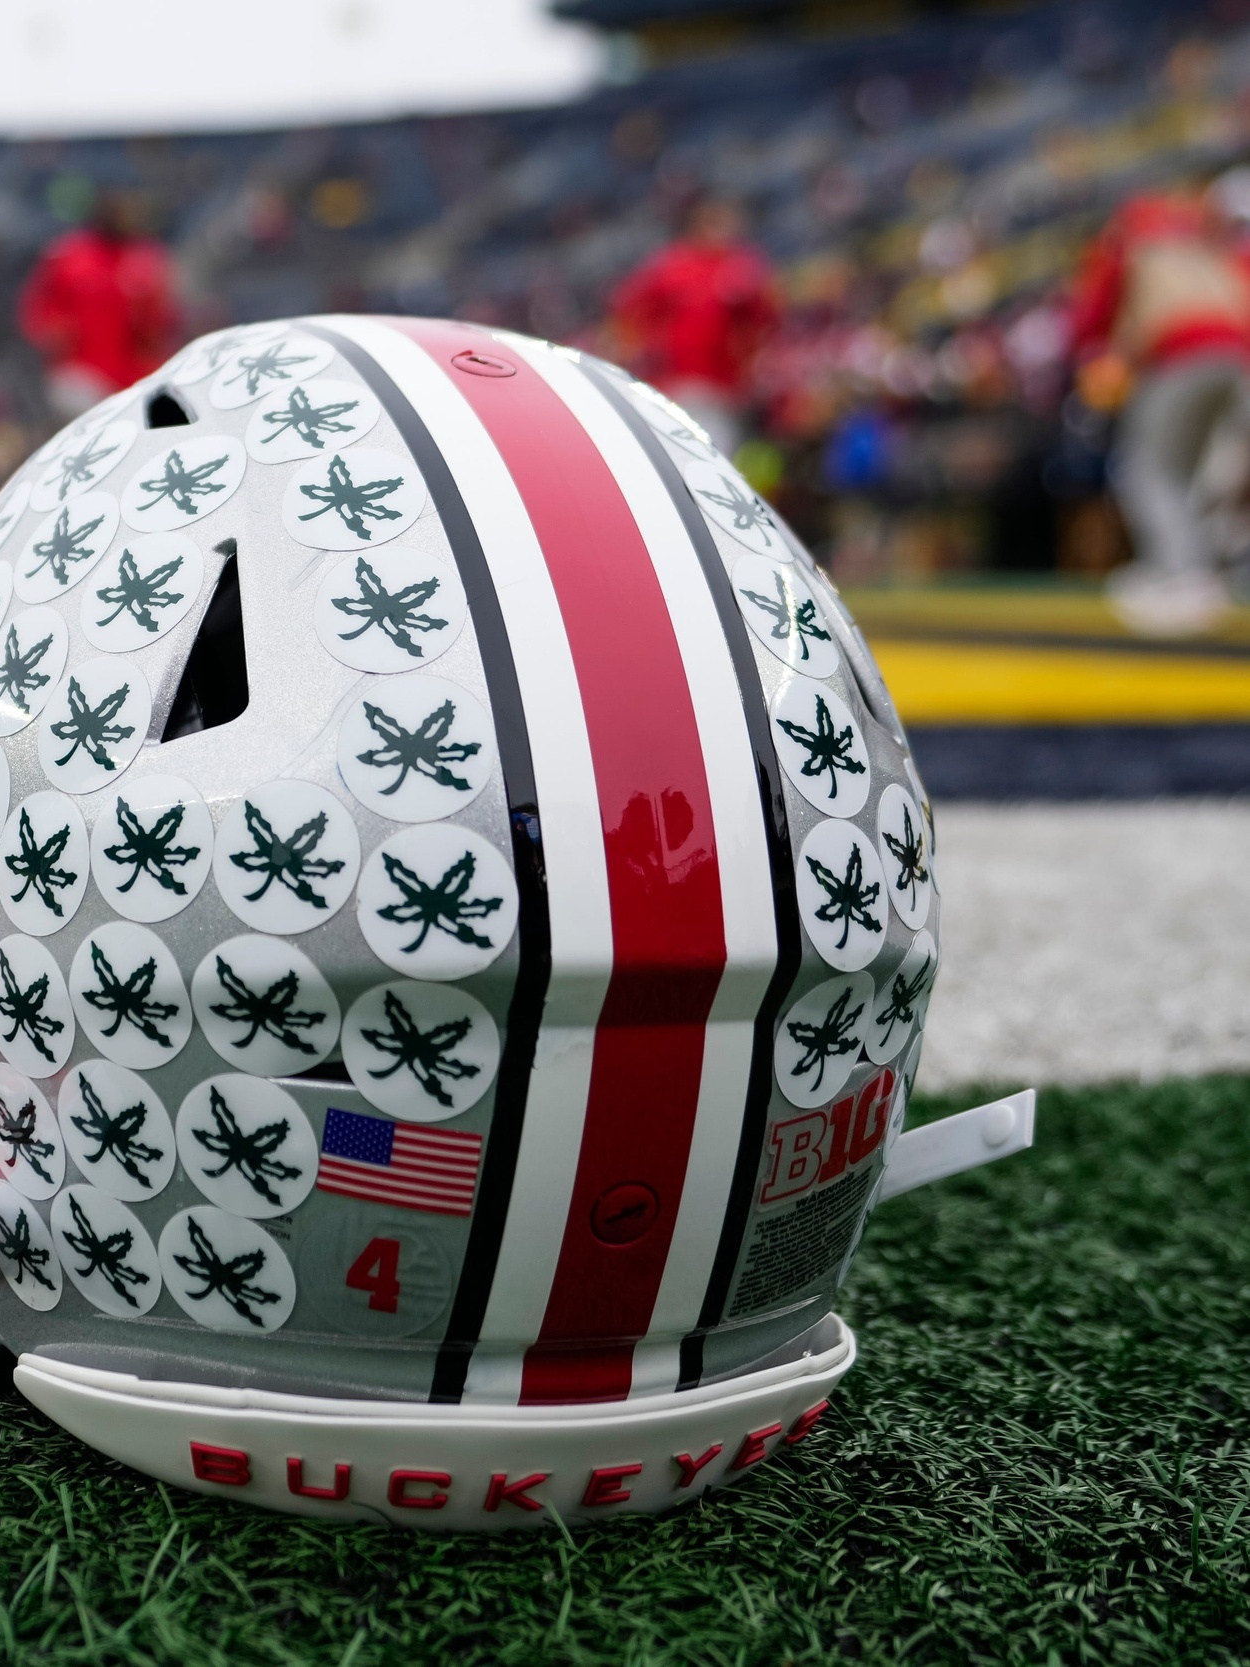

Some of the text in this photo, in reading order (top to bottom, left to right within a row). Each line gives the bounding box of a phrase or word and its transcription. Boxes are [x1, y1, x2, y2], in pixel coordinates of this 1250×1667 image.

[795, 1172, 855, 1209] WARNING
[346, 1237, 401, 1314] 4
[190, 1400, 831, 1511] BUCKEYES
